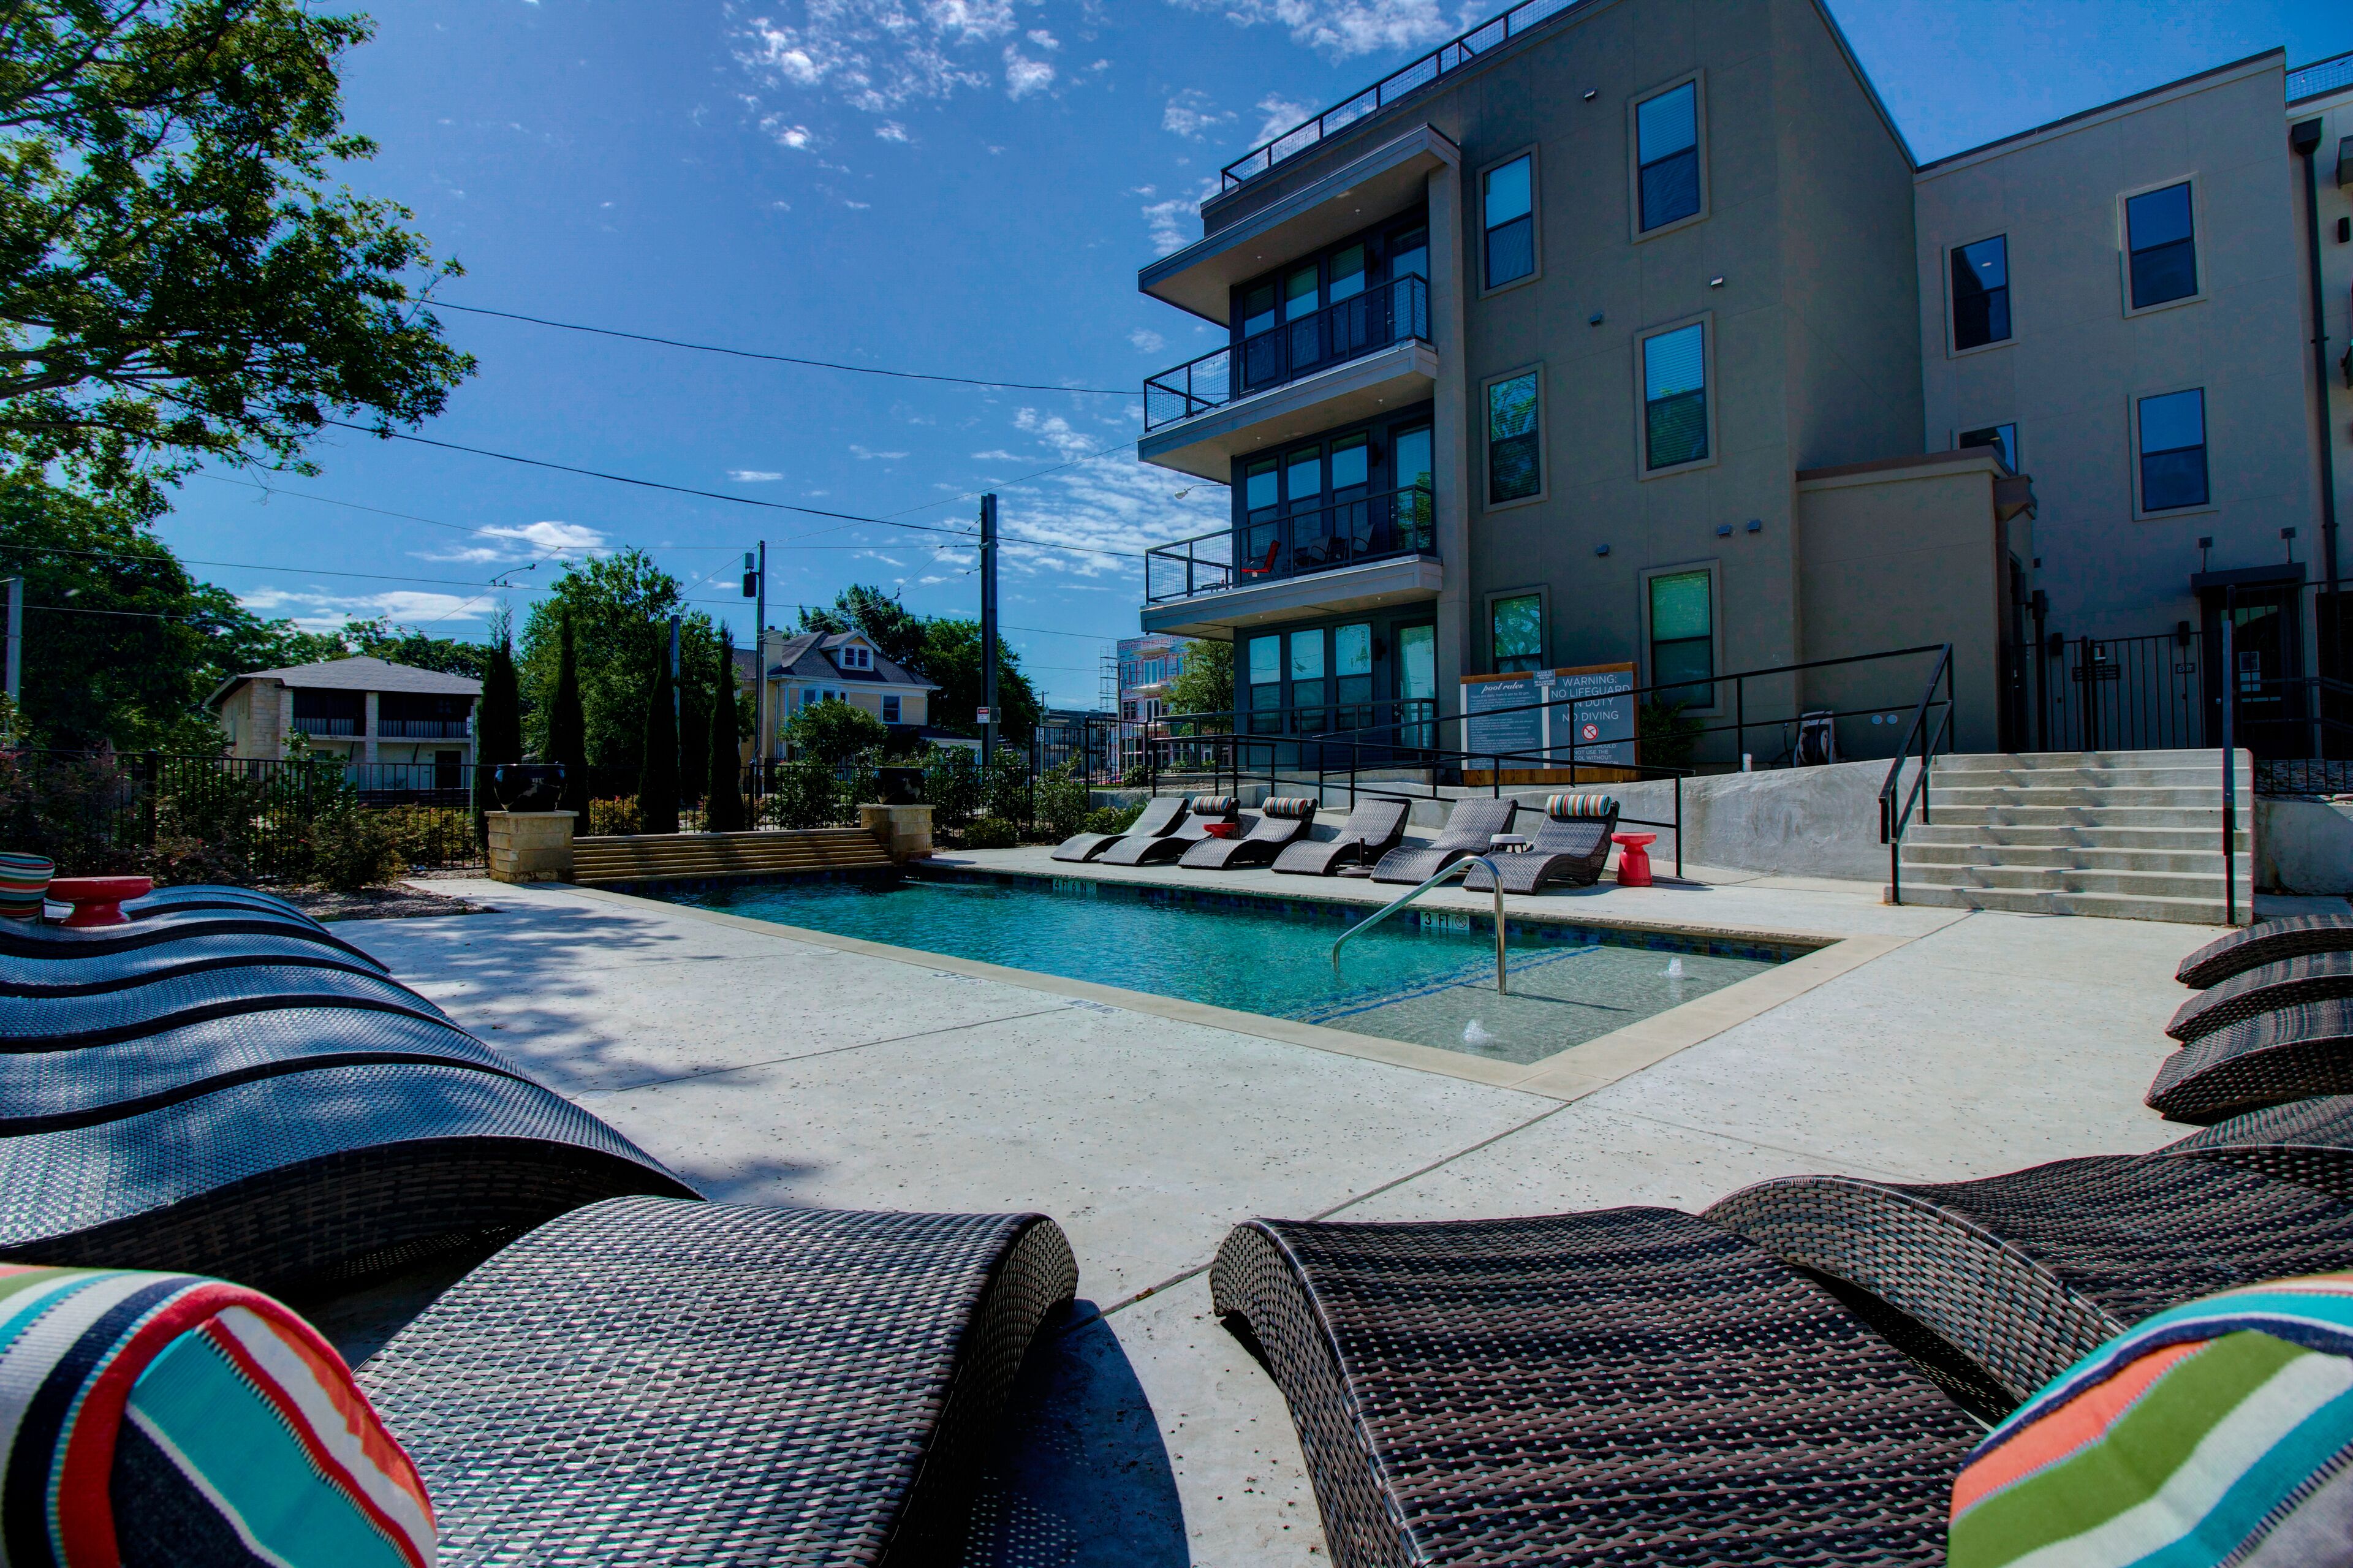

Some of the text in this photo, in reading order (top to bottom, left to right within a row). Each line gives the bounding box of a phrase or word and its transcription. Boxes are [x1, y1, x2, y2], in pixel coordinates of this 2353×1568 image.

[1481, 683, 1502, 694] pool
[1503, 681, 1524, 690] rules
[1563, 675, 1617, 687] WARNING:
[1552, 684, 1630, 699] NO LIFEGUARD
[1582, 710, 1619, 721] DIVING
[1055, 879, 1086, 892] 4 FT 6 IN
[1425, 912, 1450, 927] 3 FT
